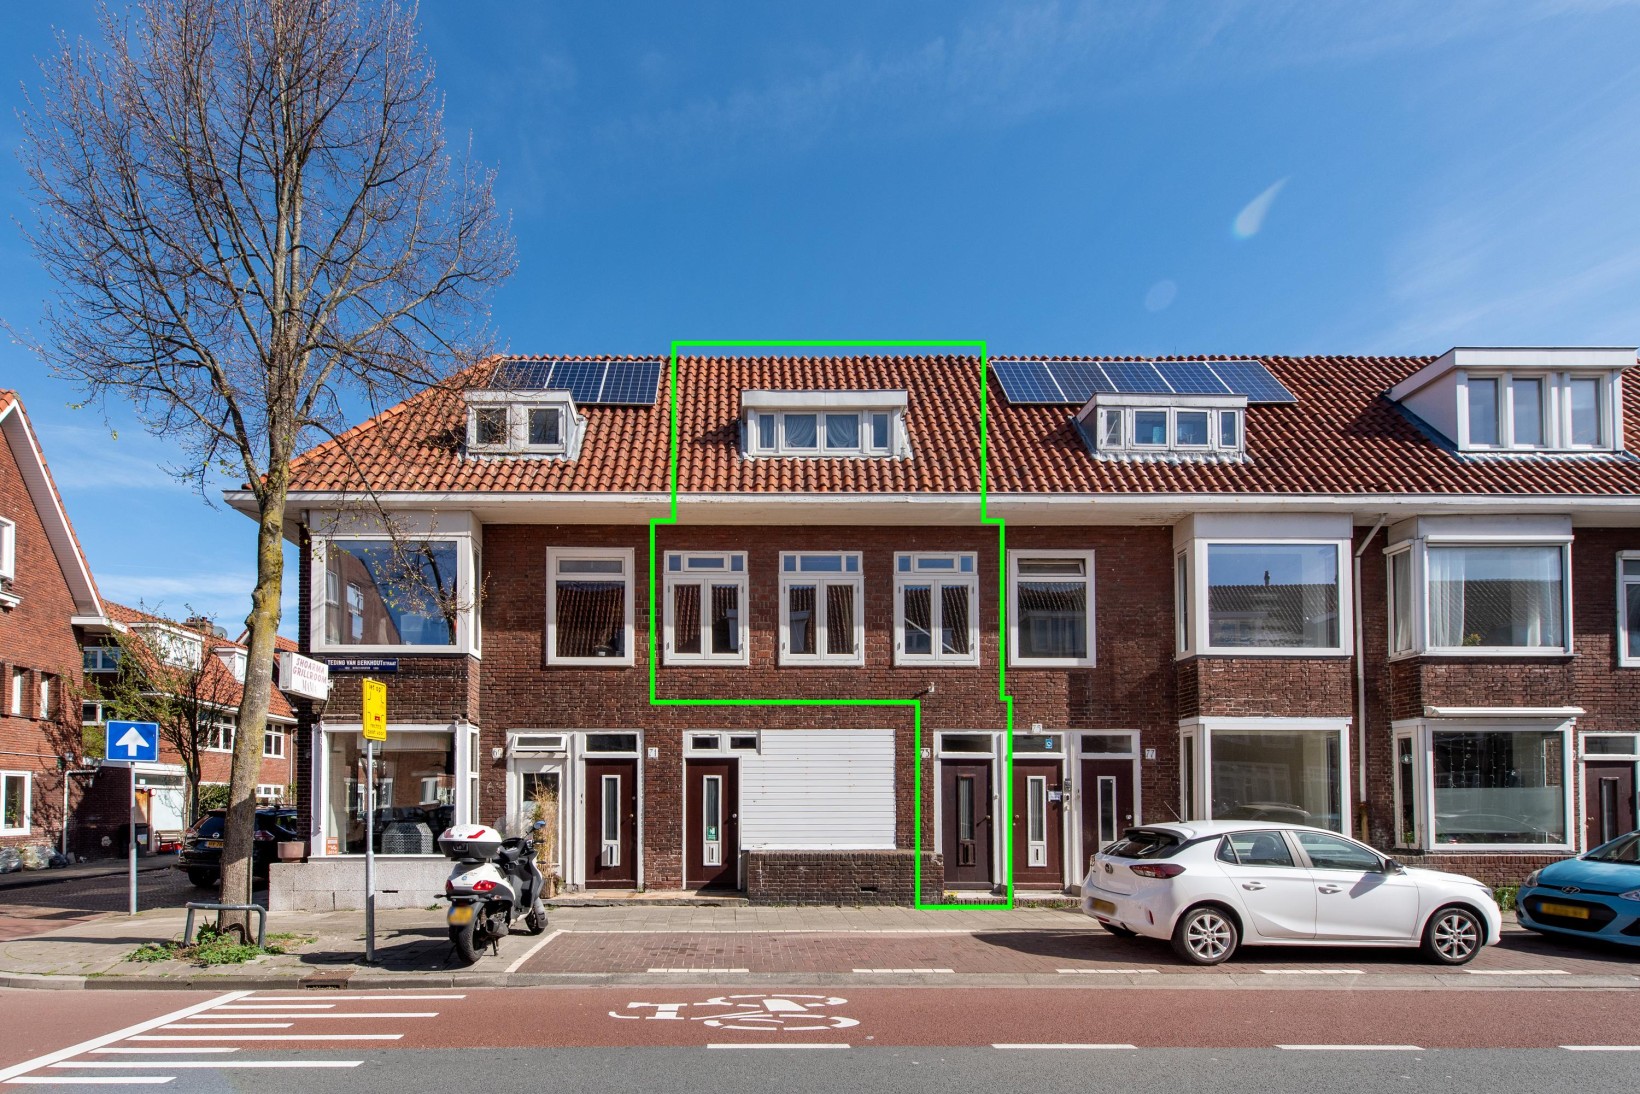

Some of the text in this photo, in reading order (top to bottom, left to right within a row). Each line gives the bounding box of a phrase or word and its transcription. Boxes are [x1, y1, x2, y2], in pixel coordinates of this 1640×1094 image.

[296, 657, 324, 674] SHOARMA
[292, 666, 327, 684] GRILLROOM
[648, 748, 656, 756] 71
[1146, 750, 1154, 758] 77
